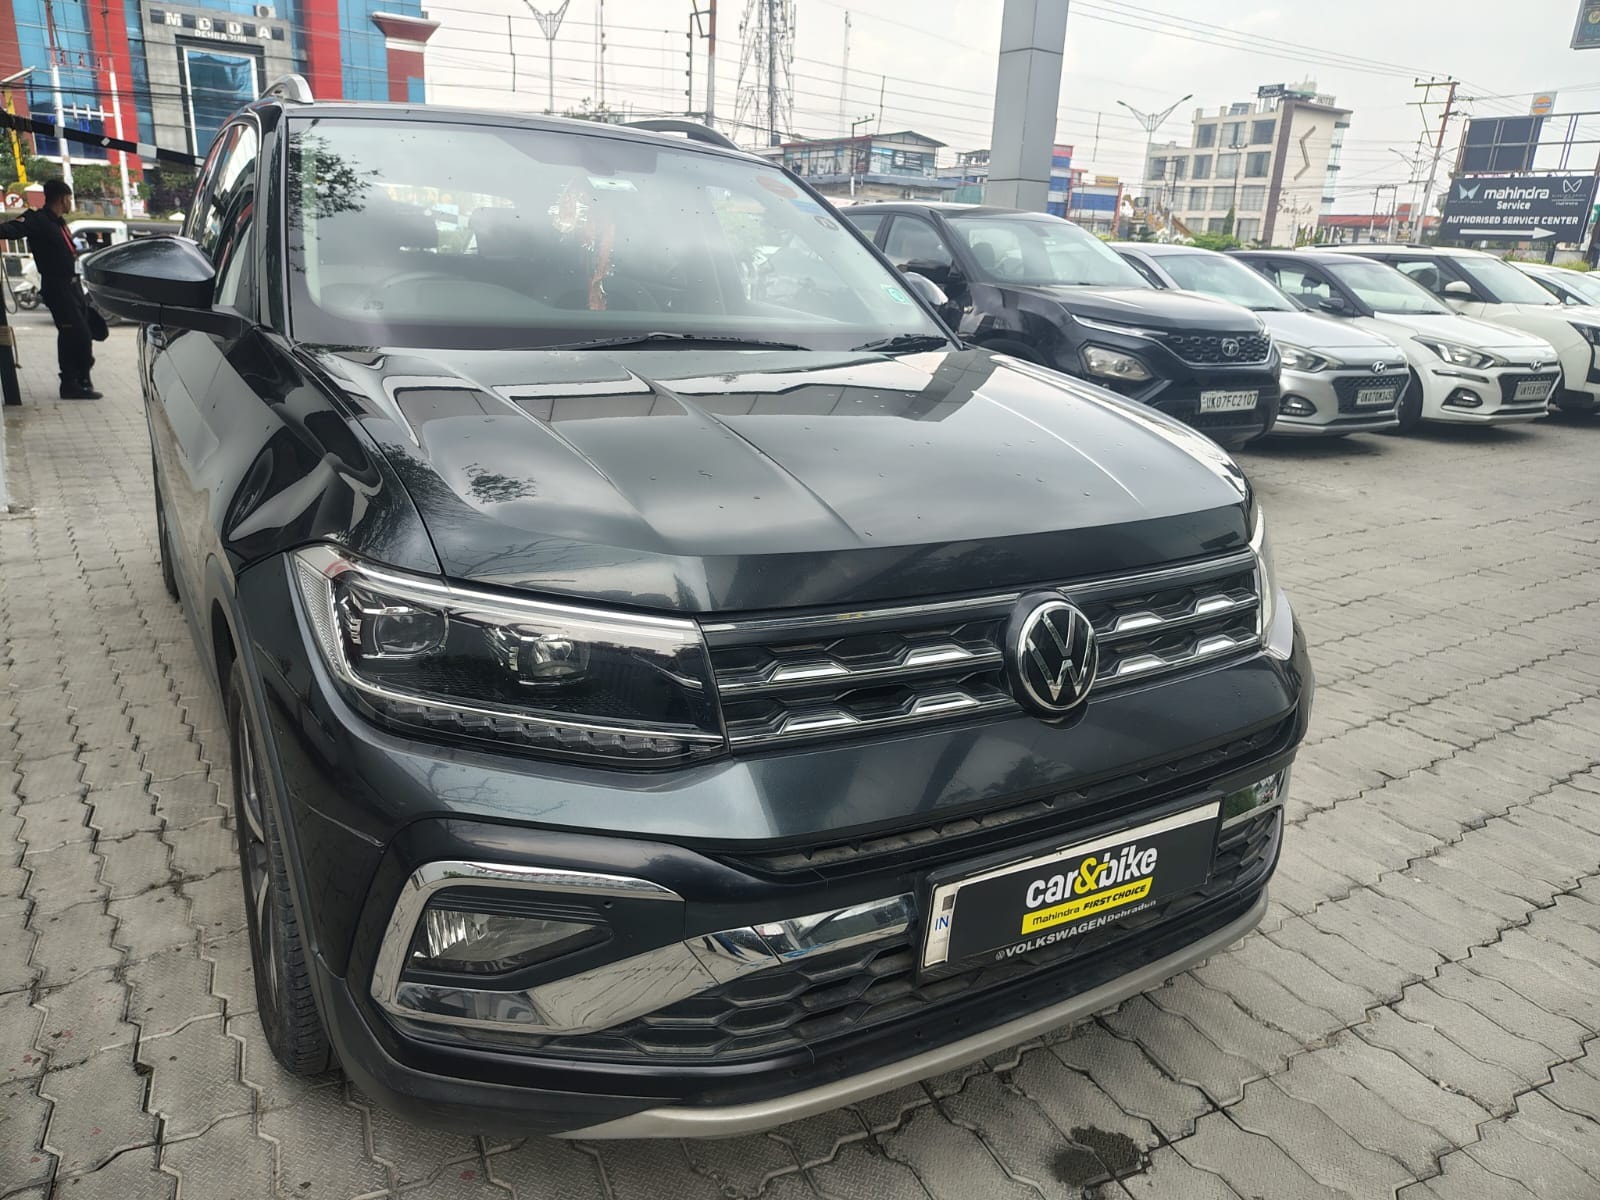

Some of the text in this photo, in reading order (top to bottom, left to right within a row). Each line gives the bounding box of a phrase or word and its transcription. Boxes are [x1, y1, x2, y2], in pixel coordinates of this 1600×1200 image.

[1483, 186, 1550, 200] mahindra
[1496, 200, 1531, 211] Service
[1446, 215, 1579, 226] AUTHORISED SERVICE CENTER
[1025, 845, 1158, 909] car&bike
[1032, 884, 1147, 926] Mahindra FIRST CHOICE
[935, 914, 950, 931] IN
[1005, 915, 1107, 958] VOLKSWAGEN
